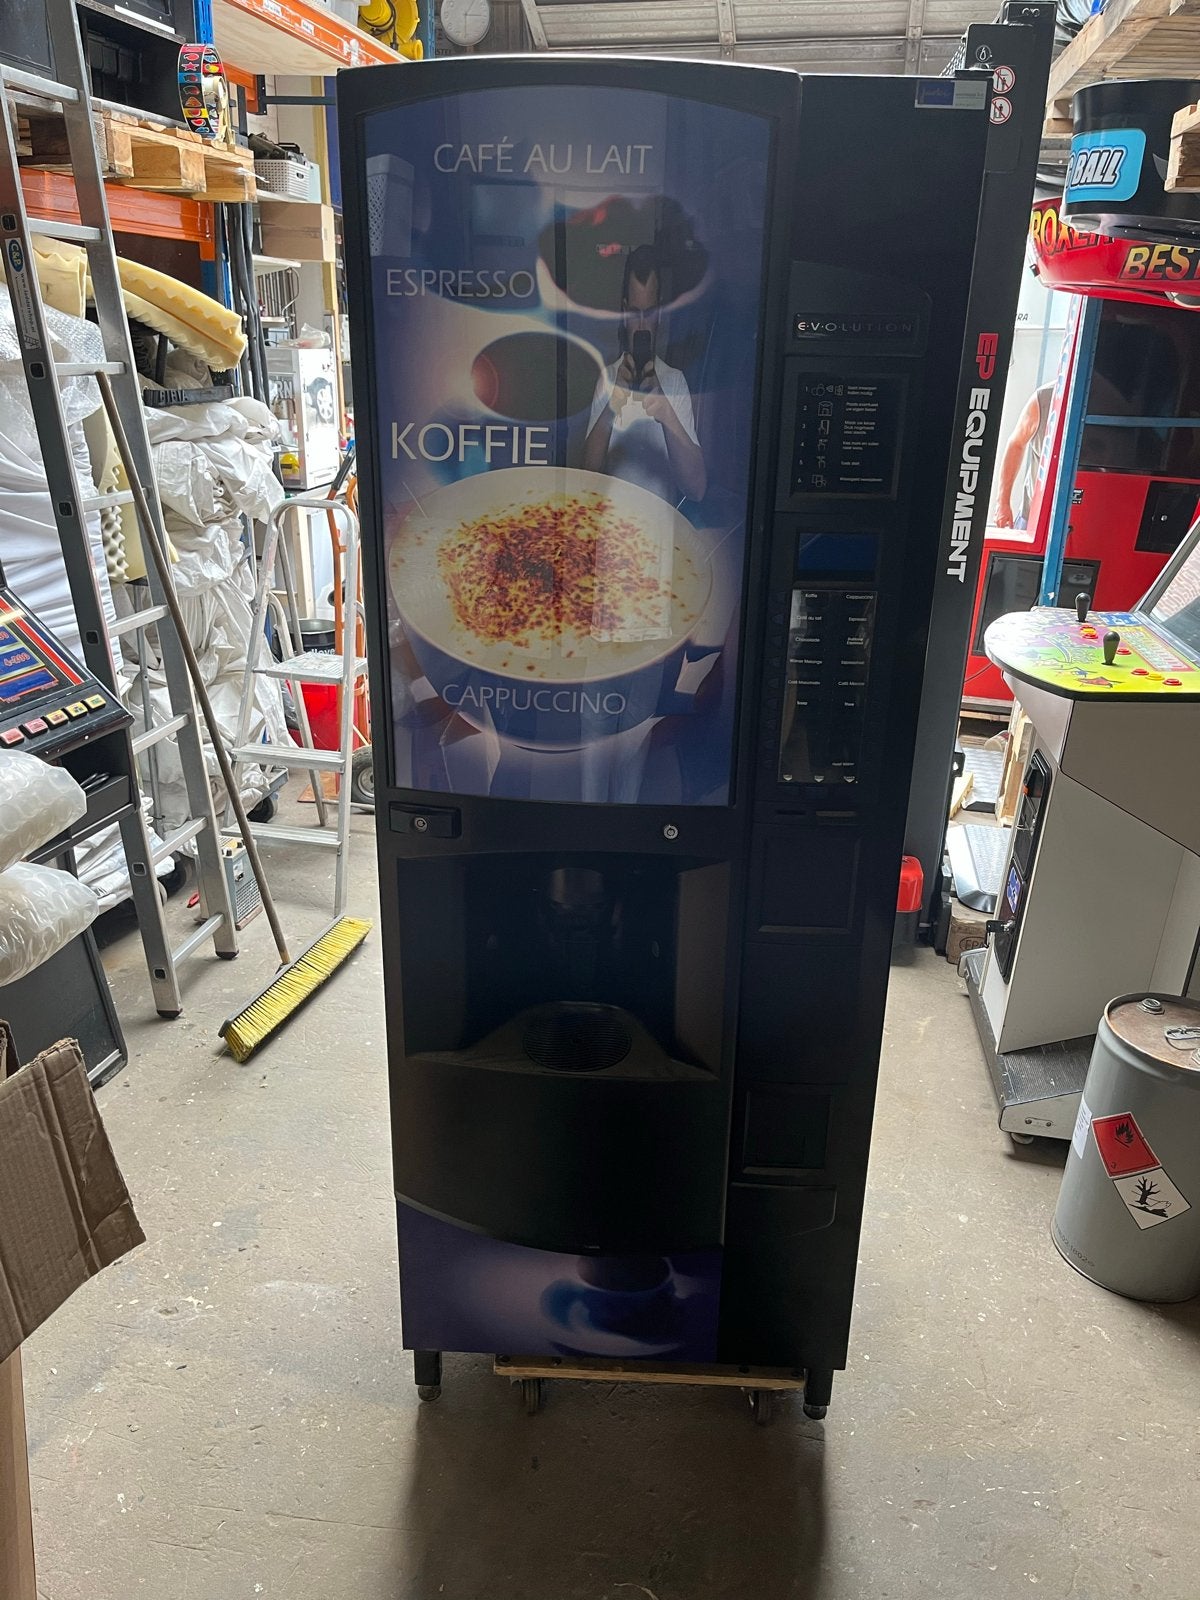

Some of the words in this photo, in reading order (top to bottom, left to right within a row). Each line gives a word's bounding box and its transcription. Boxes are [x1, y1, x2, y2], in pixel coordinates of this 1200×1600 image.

[433, 136, 514, 173] CAFÉ
[523, 144, 572, 173] AU
[586, 145, 653, 174] LAIT
[1071, 149, 1124, 187] BALL
[1120, 244, 1200, 281] BES
[386, 268, 536, 298] ESPRESSO
[975, 333, 999, 380] EP
[391, 422, 549, 465] KOFFIE
[946, 387, 991, 584] EQUIPMENT
[442, 684, 626, 715] CAPPUCCINO
